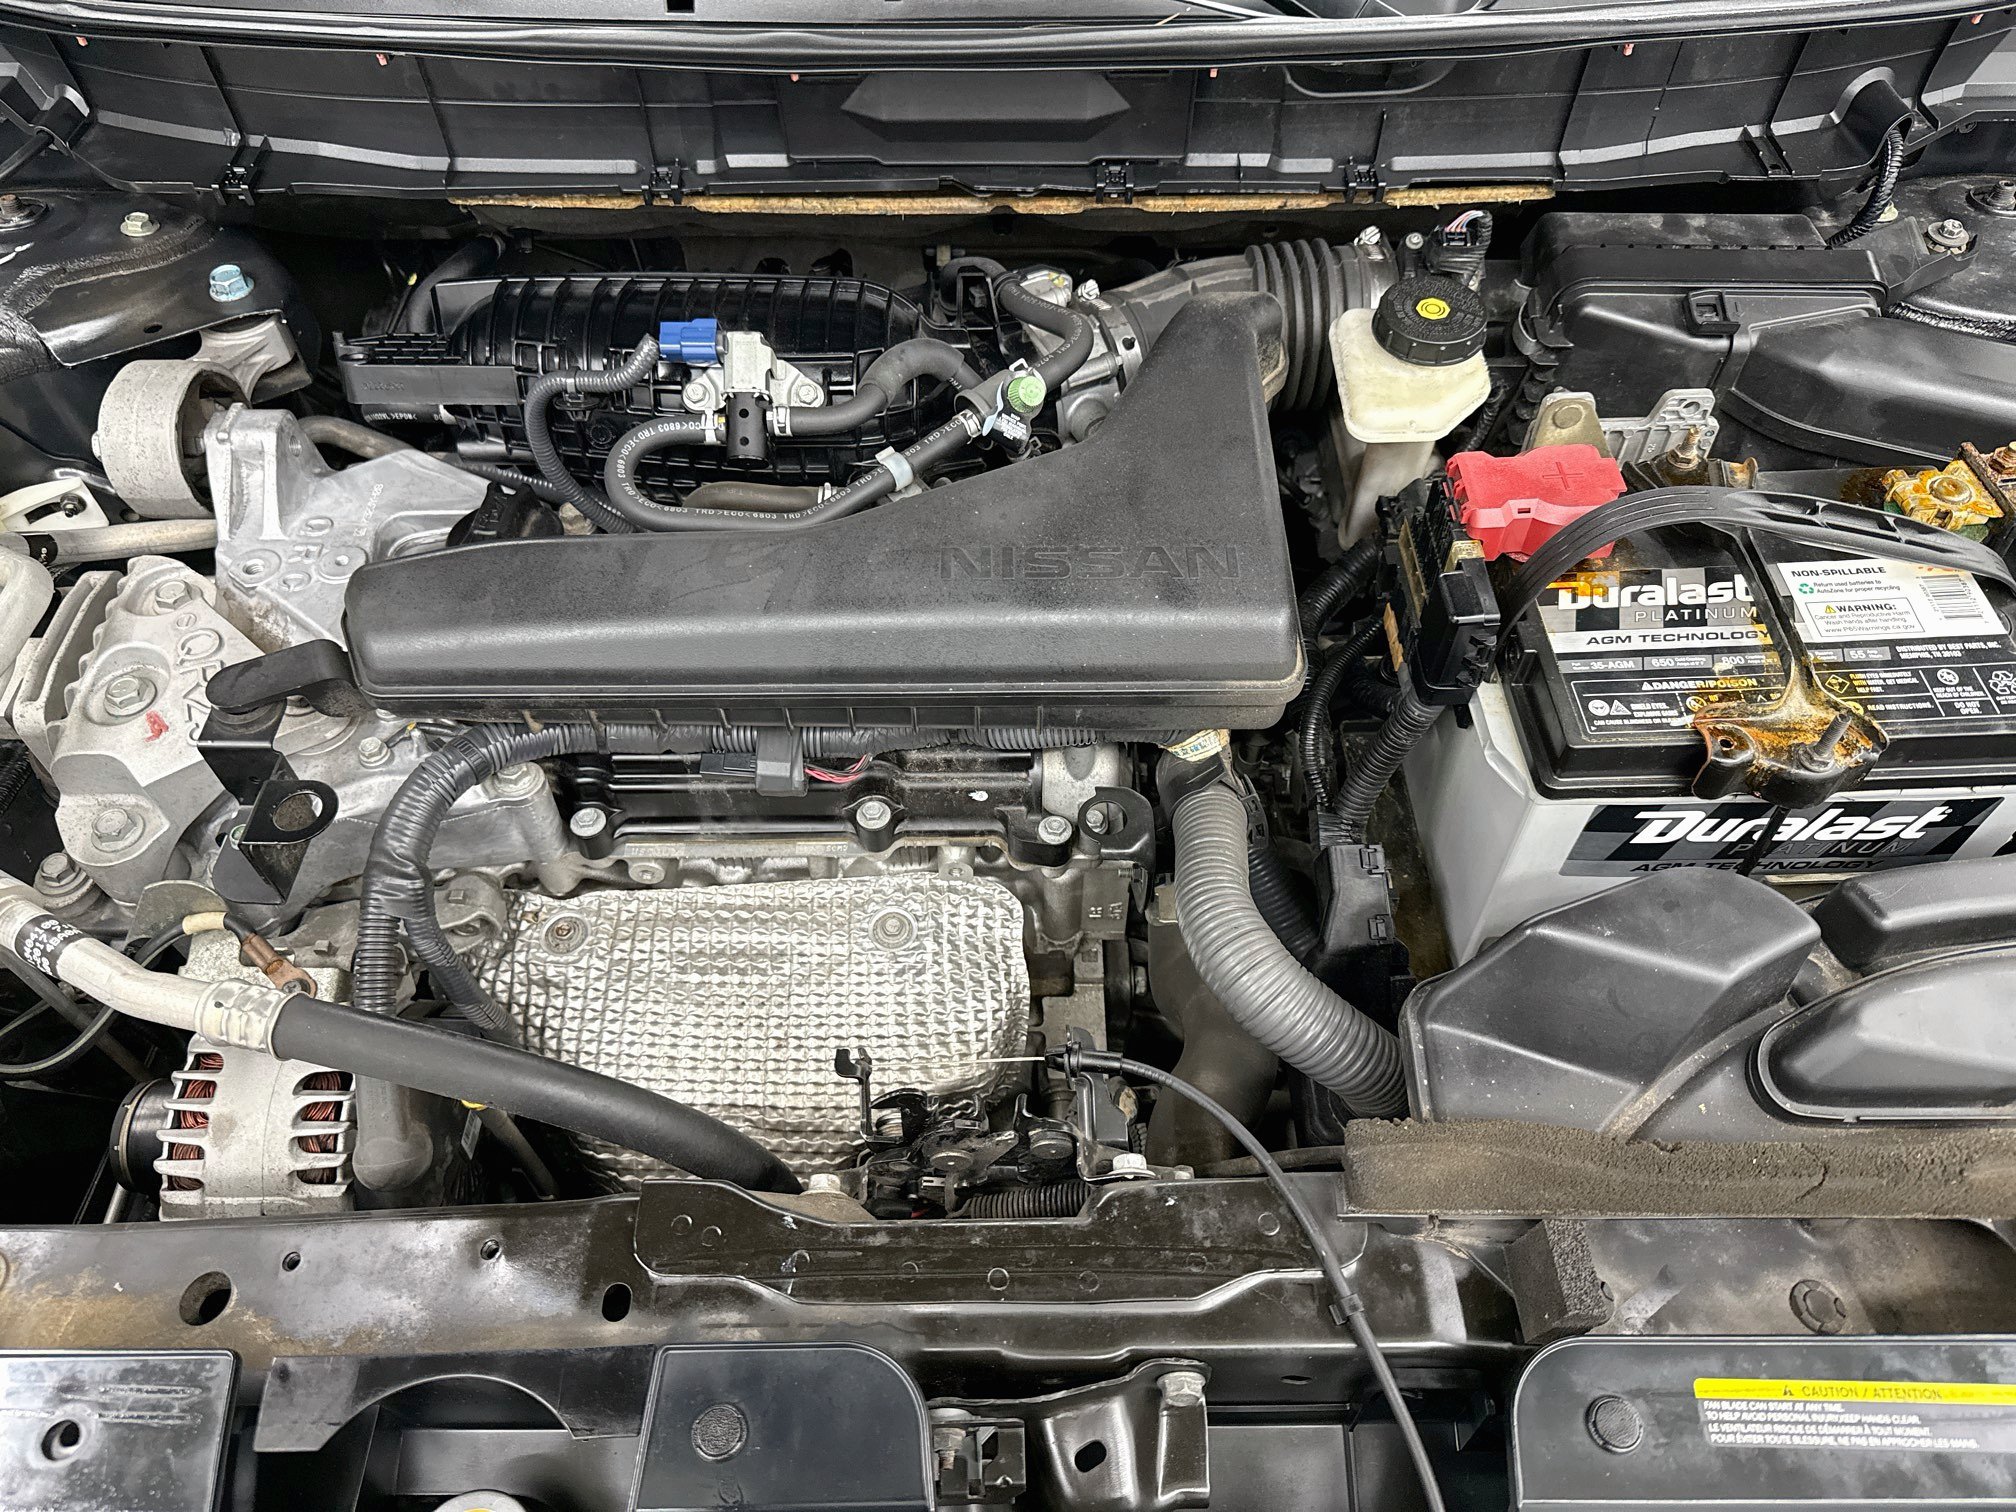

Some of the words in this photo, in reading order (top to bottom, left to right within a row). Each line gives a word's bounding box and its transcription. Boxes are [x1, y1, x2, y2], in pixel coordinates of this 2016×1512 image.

[940, 546, 1240, 580] NISSAN
[1791, 566, 1887, 578] NON-SPILLABLE
[1546, 573, 1755, 611] Duralast
[1635, 606, 1758, 623] PLATINUM
[1836, 603, 1897, 613] WARNING:
[1586, 635, 1632, 646] AGM
[1639, 630, 1770, 643] TECHNOLOGY
[1937, 643, 1947, 651] BY
[1721, 655, 1745, 666] 800
[1849, 650, 1867, 659] 55
[1590, 660, 1636, 670] 35-AGM
[1651, 658, 1674, 668] 650
[1652, 677, 1758, 691] DANGER/POISON
[1629, 806, 1950, 844] Duralast
[1728, 841, 1915, 856] PATINUM
[1801, 1385, 1858, 1398] CAUTION
[1873, 1387, 1942, 1400] ATTENTION
